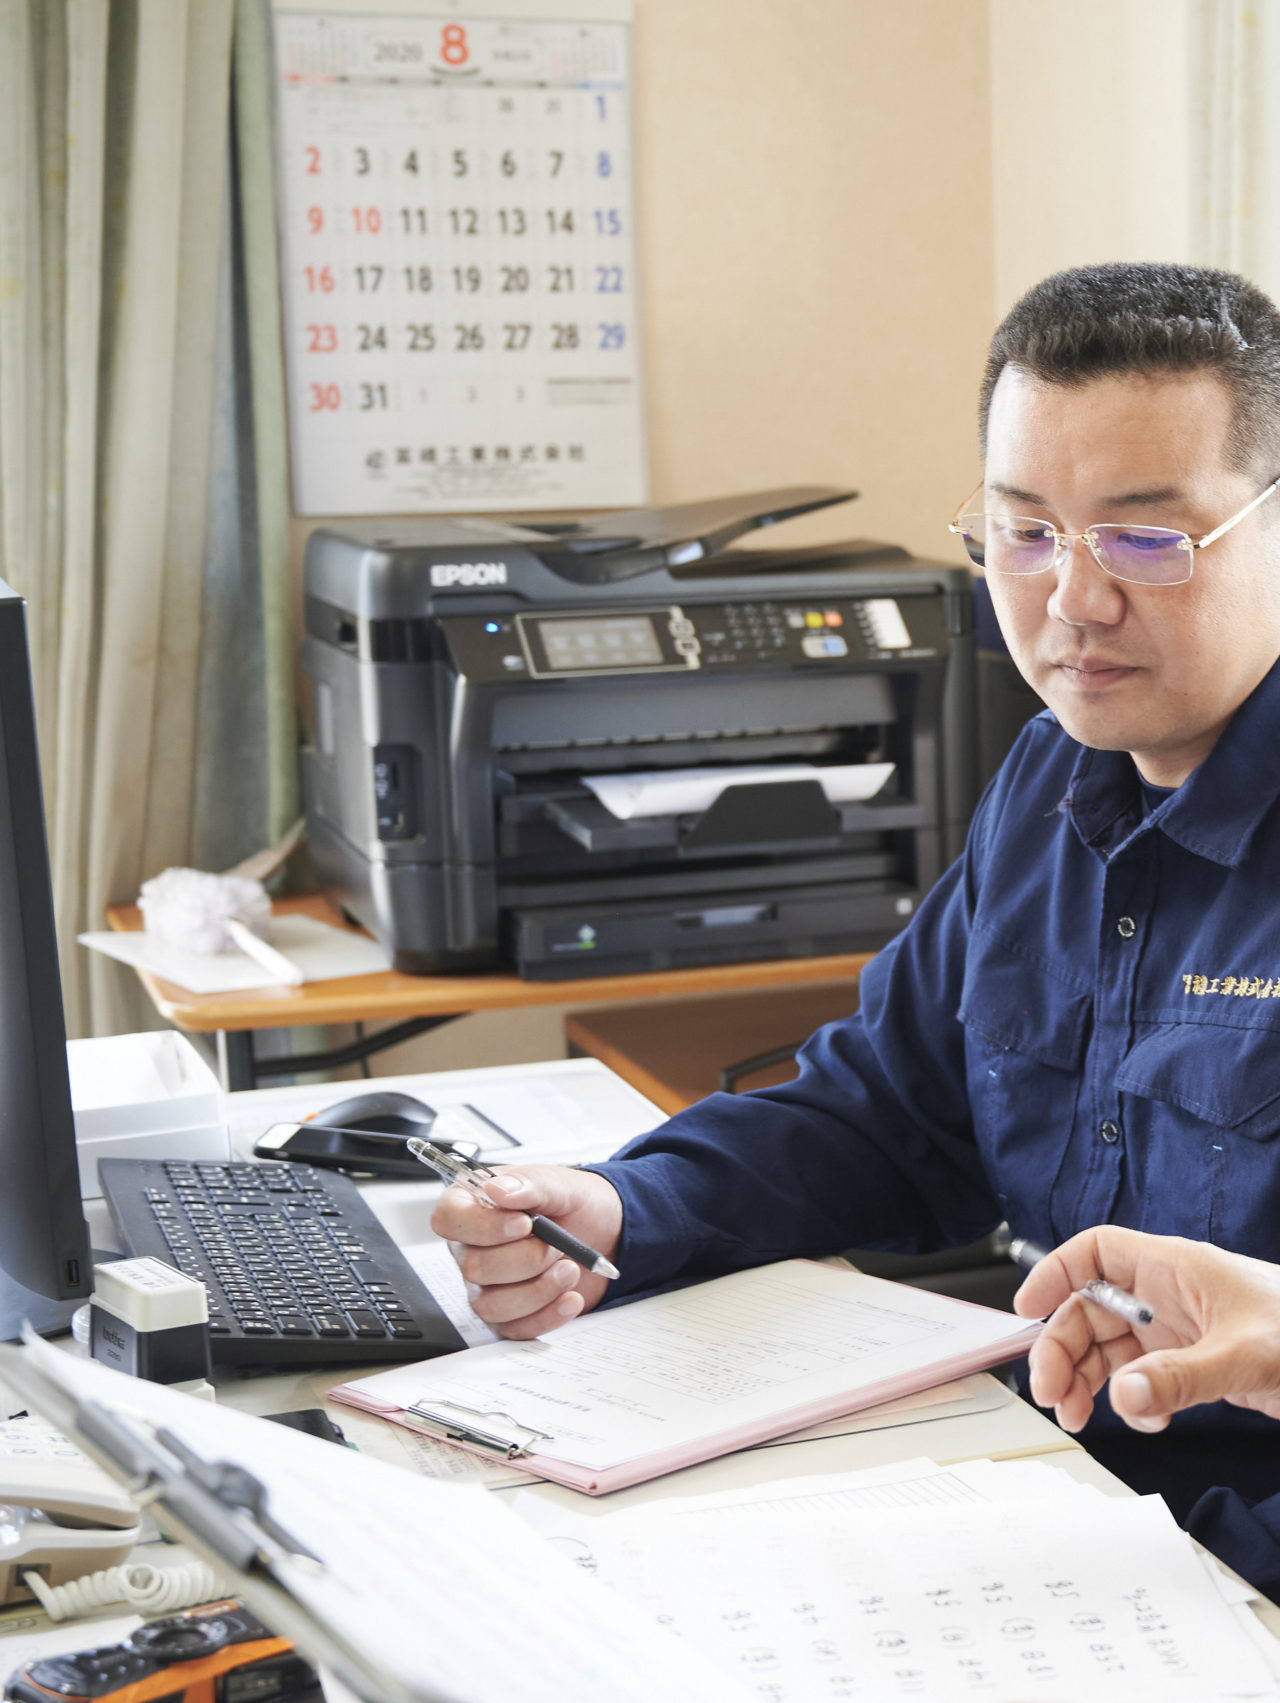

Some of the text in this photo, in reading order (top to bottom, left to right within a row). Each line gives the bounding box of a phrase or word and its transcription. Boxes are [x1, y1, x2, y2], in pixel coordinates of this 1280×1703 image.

[440, 24, 469, 66] 8
[596, 95, 606, 119] 1
[305, 146, 611, 178] 2 3 4 5 6 7 8
[307, 206, 621, 236] 9 10 11 12 13 14 15
[303, 265, 623, 294] 16 17 18 19 20 21 22
[306, 323, 625, 353] 23 24 25 26 27 28 29
[309, 383, 341, 412] 30
[359, 383, 388, 411] 31
[431, 562, 507, 588] EPSON
